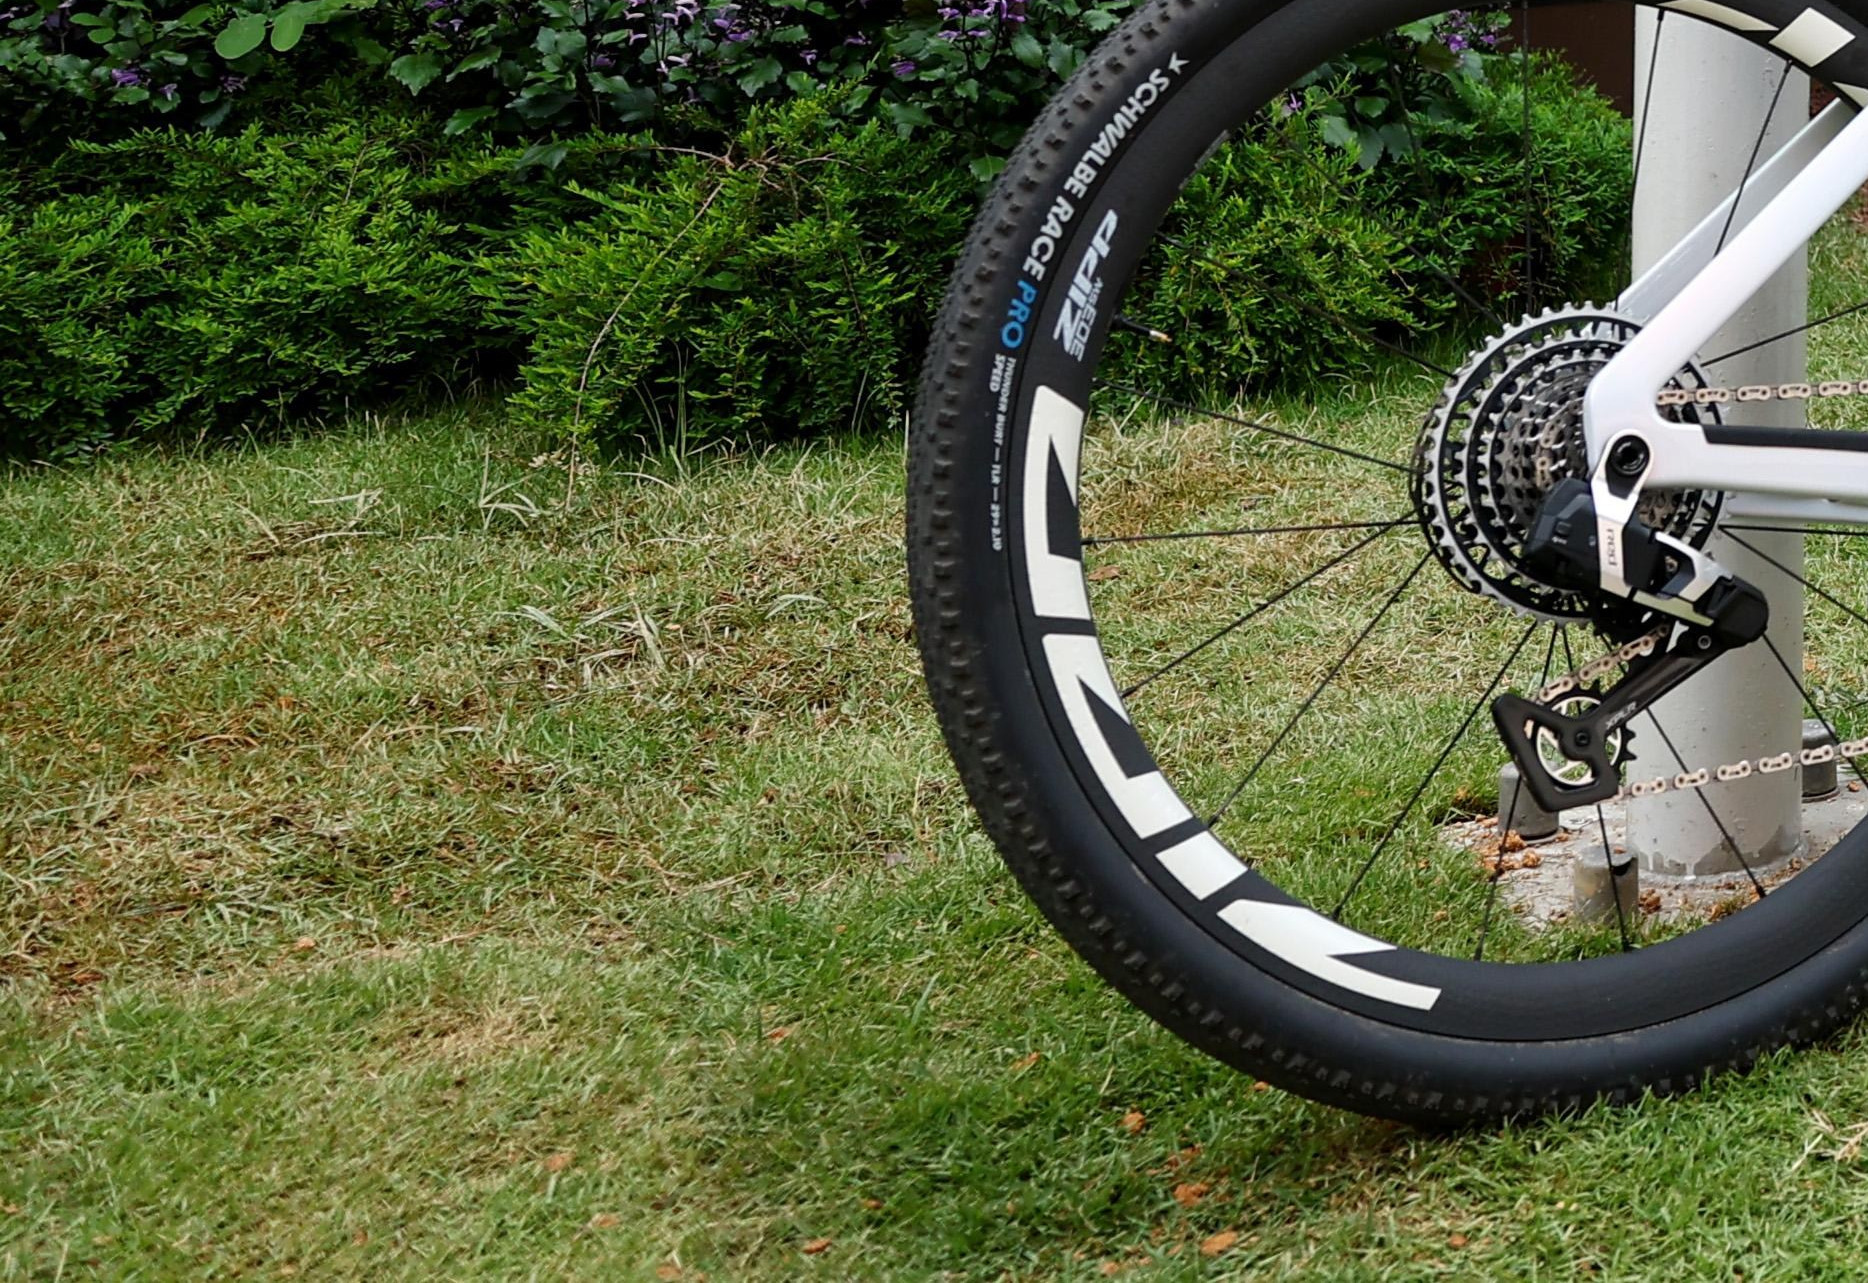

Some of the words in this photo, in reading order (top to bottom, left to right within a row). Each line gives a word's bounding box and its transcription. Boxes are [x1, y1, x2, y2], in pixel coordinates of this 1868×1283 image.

[1066, 67, 1171, 199] SCHWALBE
[1024, 194, 1075, 281] RACE
[1001, 278, 1037, 349] PRO
[1050, 207, 1117, 352] ZIPP
[988, 353, 1006, 392] SPEED
[996, 356, 1016, 413] THUNDER
